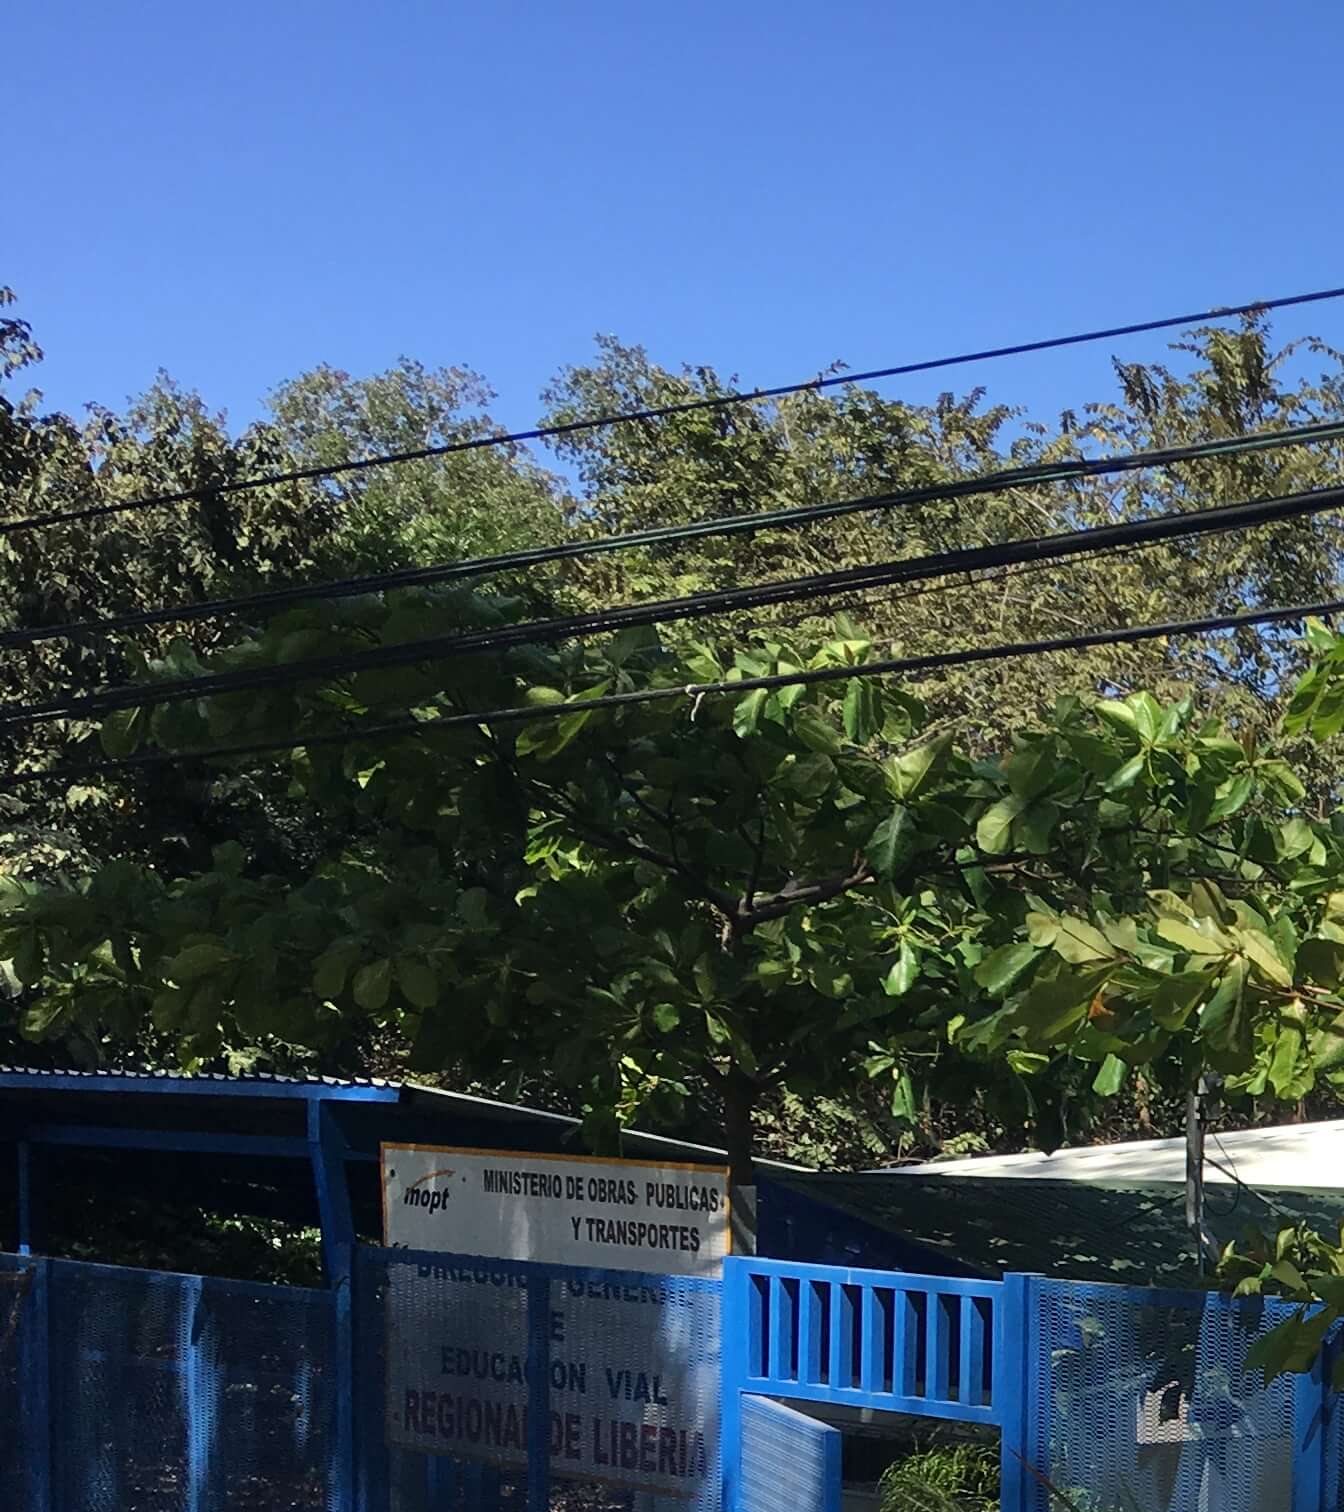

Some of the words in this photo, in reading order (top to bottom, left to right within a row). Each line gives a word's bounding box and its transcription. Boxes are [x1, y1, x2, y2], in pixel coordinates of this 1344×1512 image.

[483, 1168, 562, 1200] MINISTERIO
[566, 1176, 584, 1202] DE
[588, 1178, 636, 1206] OBRAS
[646, 1182, 719, 1213] PUBLICAS
[571, 1216, 582, 1240] Y
[585, 1219, 700, 1251] TRANSPORTES
[440, 1346, 586, 1394] EDUCAON
[606, 1368, 668, 1406] VIAL
[404, 1388, 528, 1450] REGIONA
